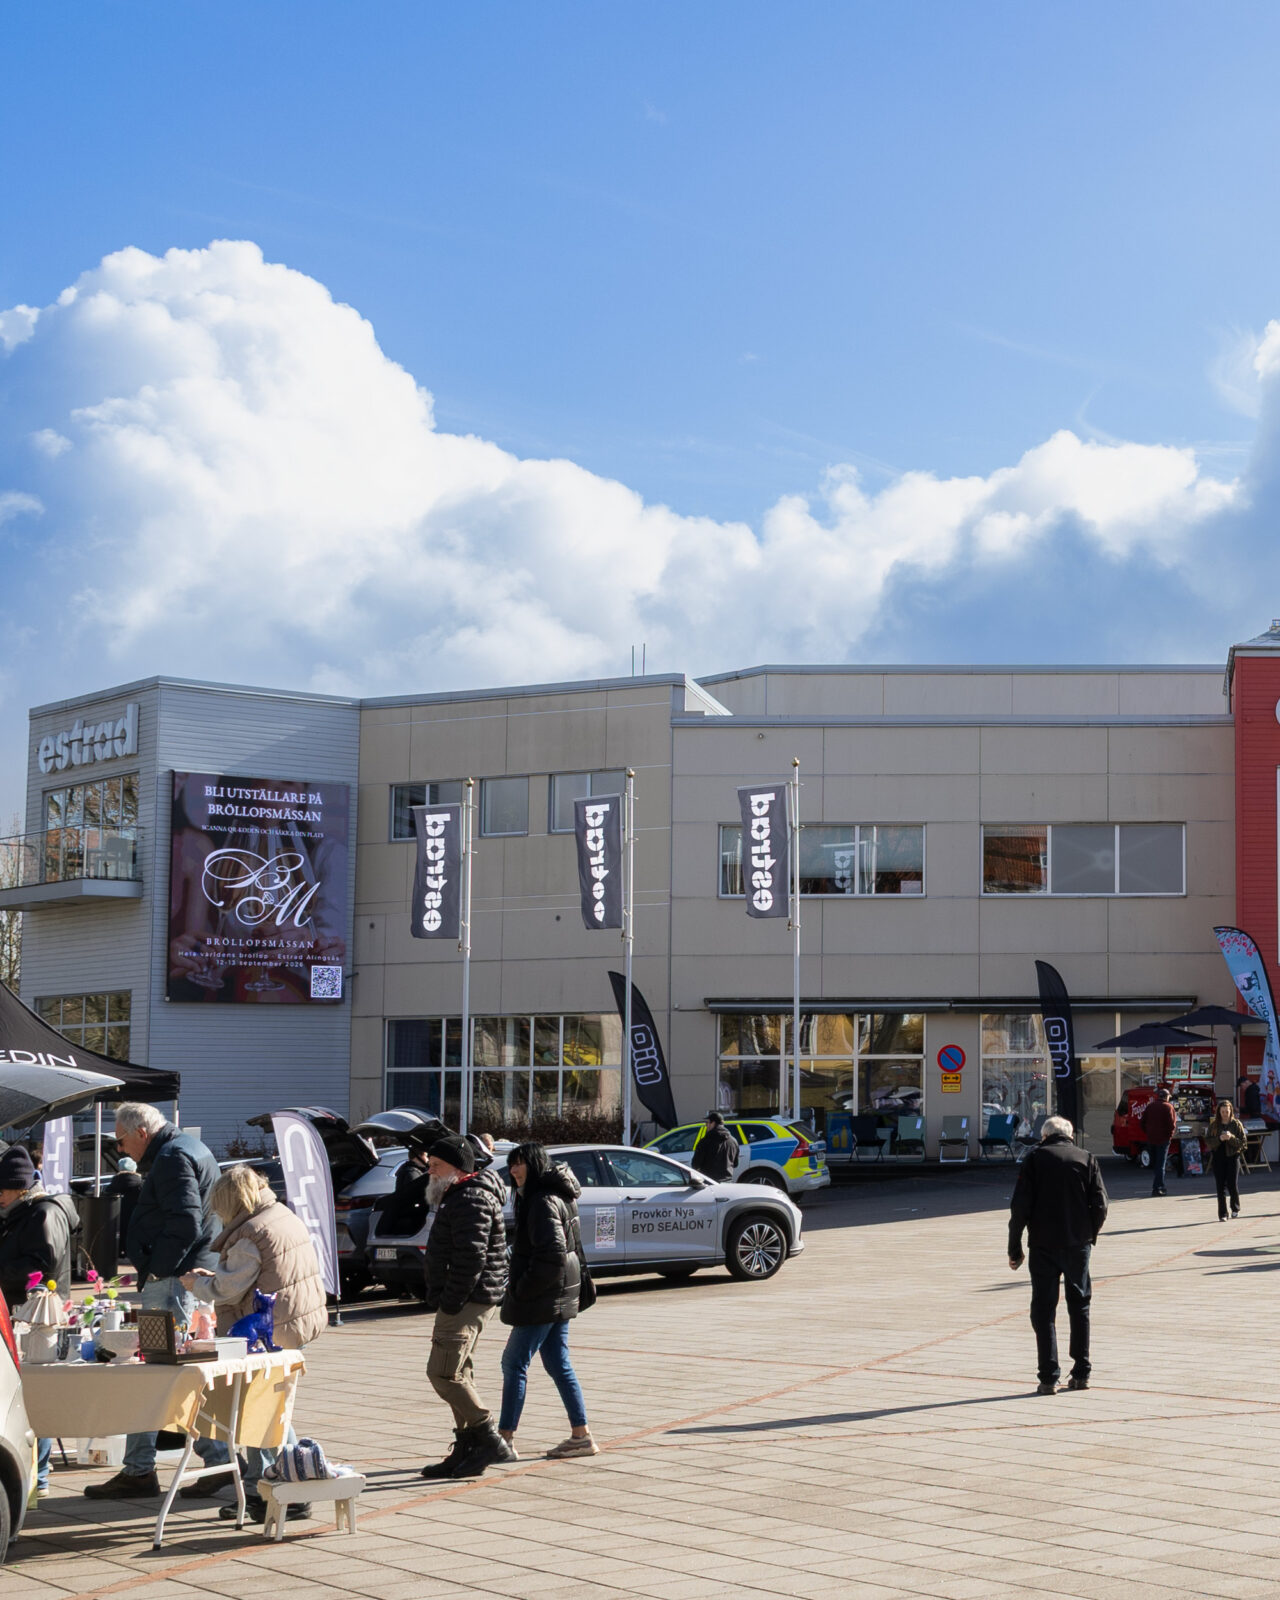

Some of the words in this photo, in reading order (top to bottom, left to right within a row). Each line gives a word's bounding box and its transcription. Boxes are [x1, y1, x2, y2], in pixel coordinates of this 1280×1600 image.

[37, 703, 139, 774] estrad
[204, 785, 224, 798] BLI
[227, 788, 306, 804] UTSTÄLLARE
[308, 792, 323, 805] PÅ
[208, 803, 322, 822] BRÖLLOPSMÄSSAN
[206, 937, 315, 949] BRÖLLOPSMÄSSAN
[632, 1208, 672, 1220] Provkör
[675, 1207, 695, 1219] Nya
[632, 1223, 655, 1234] BYD
[657, 1220, 704, 1232] SEALION
[707, 1219, 713, 1229] 7
